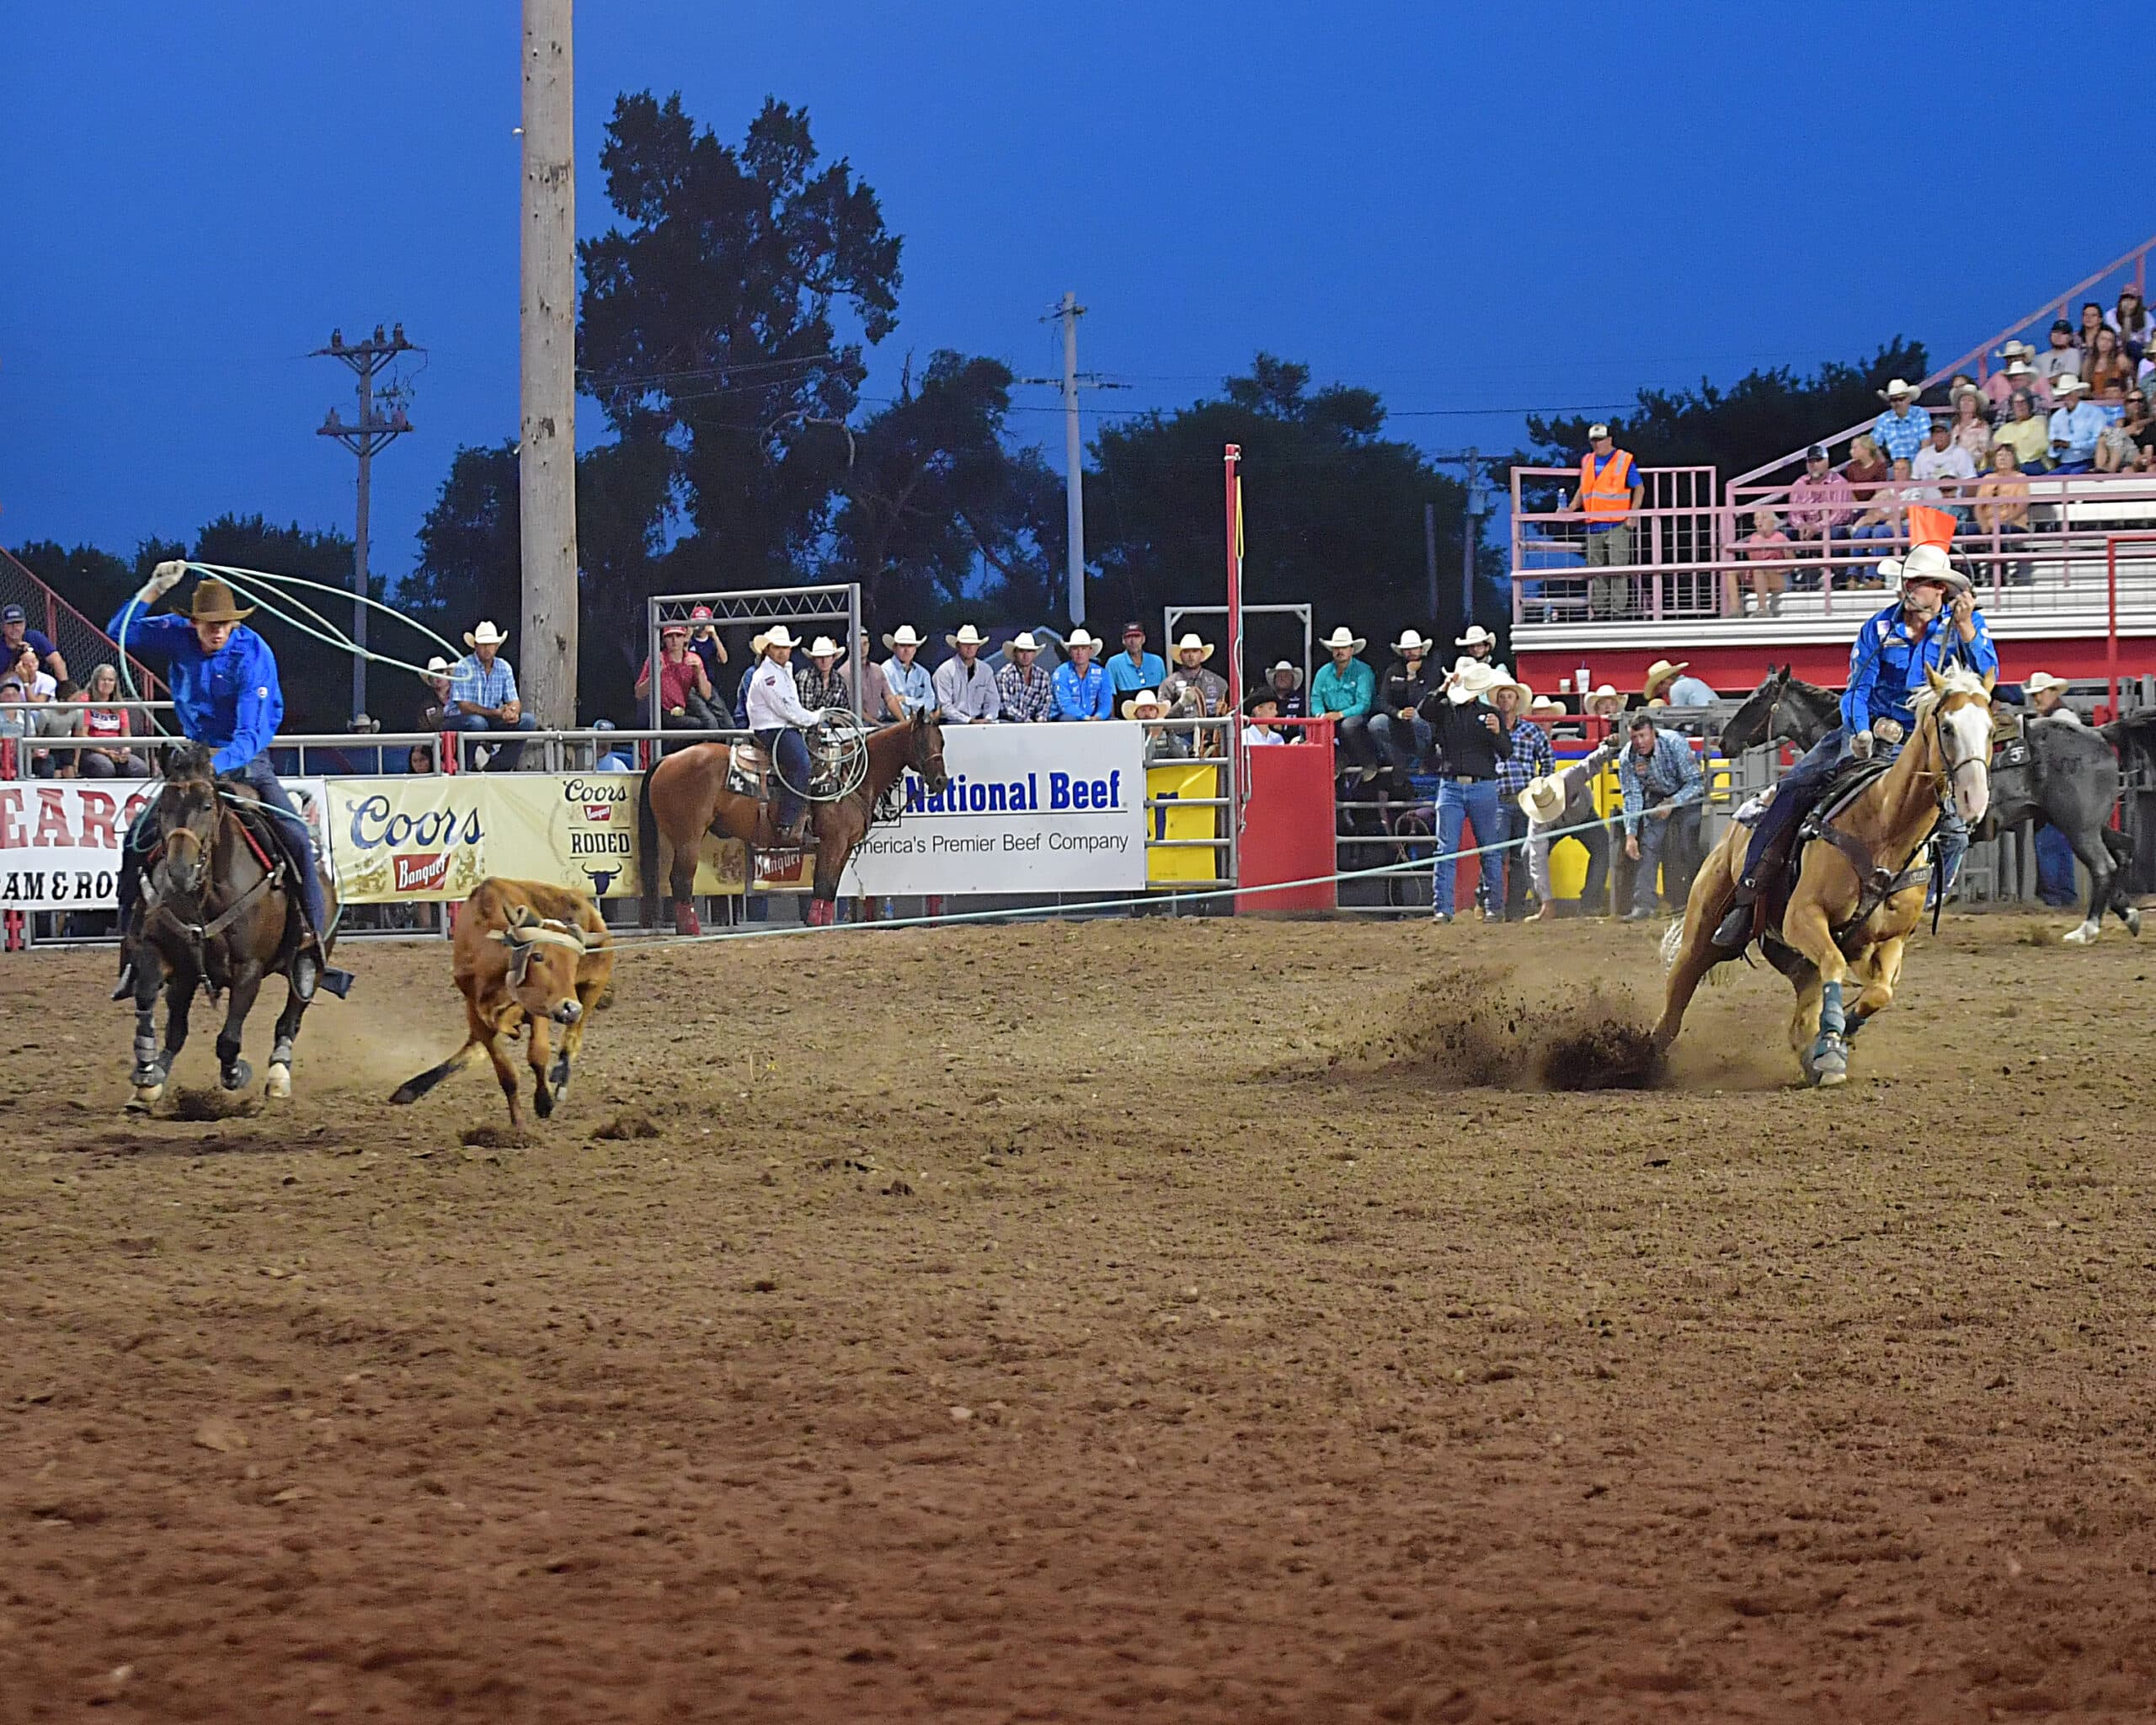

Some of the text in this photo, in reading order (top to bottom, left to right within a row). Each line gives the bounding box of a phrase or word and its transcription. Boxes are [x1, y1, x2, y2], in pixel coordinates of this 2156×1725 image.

[563, 778, 628, 802] Coors
[905, 770, 1120, 813] National Beef
[345, 794, 485, 850] Coors
[571, 833, 630, 853] RODEO
[854, 832, 1129, 854] merica's Premier Beef Company
[51, 871, 69, 900] &
[398, 857, 448, 889] Banquet
